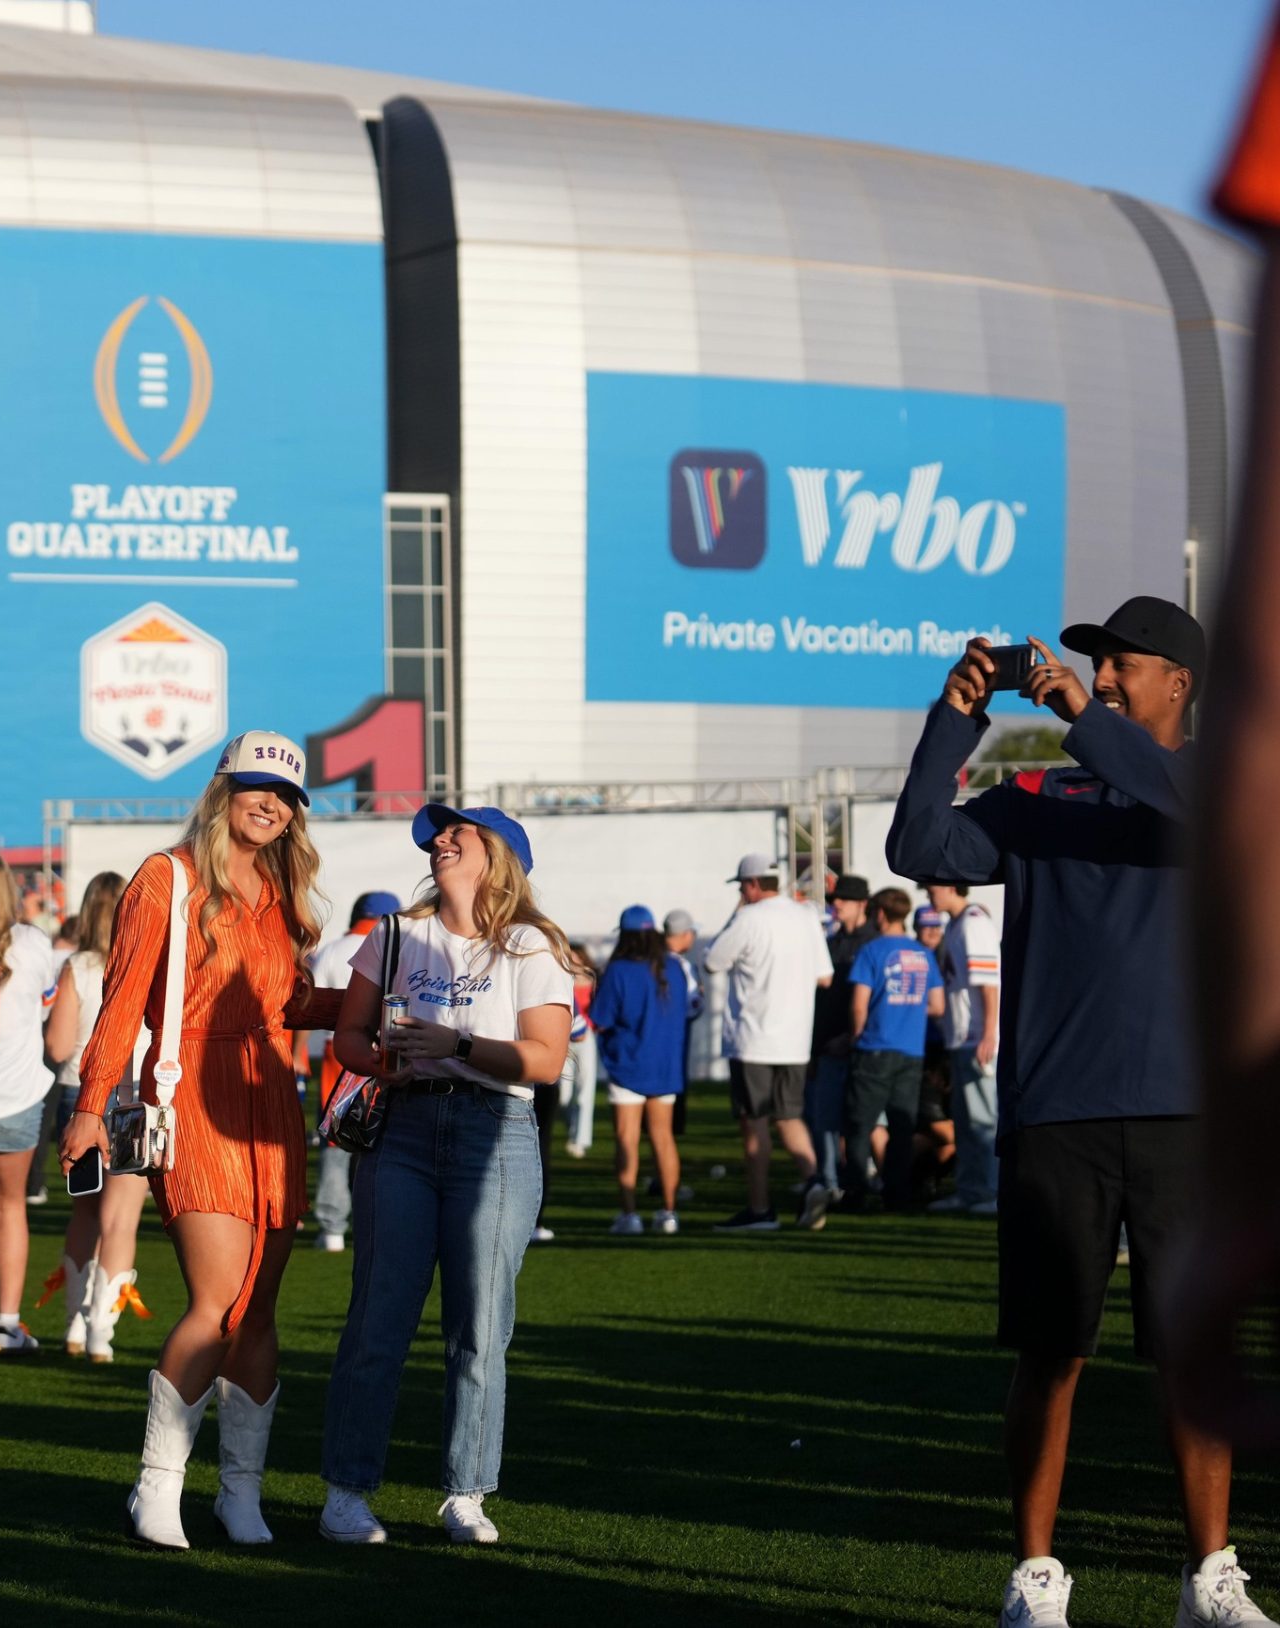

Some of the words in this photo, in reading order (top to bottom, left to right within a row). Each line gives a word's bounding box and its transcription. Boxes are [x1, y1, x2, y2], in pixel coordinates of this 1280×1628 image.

[71, 484, 238, 521] PLAYOFF
[787, 460, 1017, 577] Vrbo
[7, 521, 299, 562] QUARTERFINAL
[663, 611, 776, 651] Private
[780, 615, 914, 656] Vacation
[254, 746, 302, 775] BOISE
[305, 693, 426, 815] 1
[408, 969, 452, 993] Boise
[451, 973, 492, 997] State
[424, 993, 469, 1007] BRONOS
